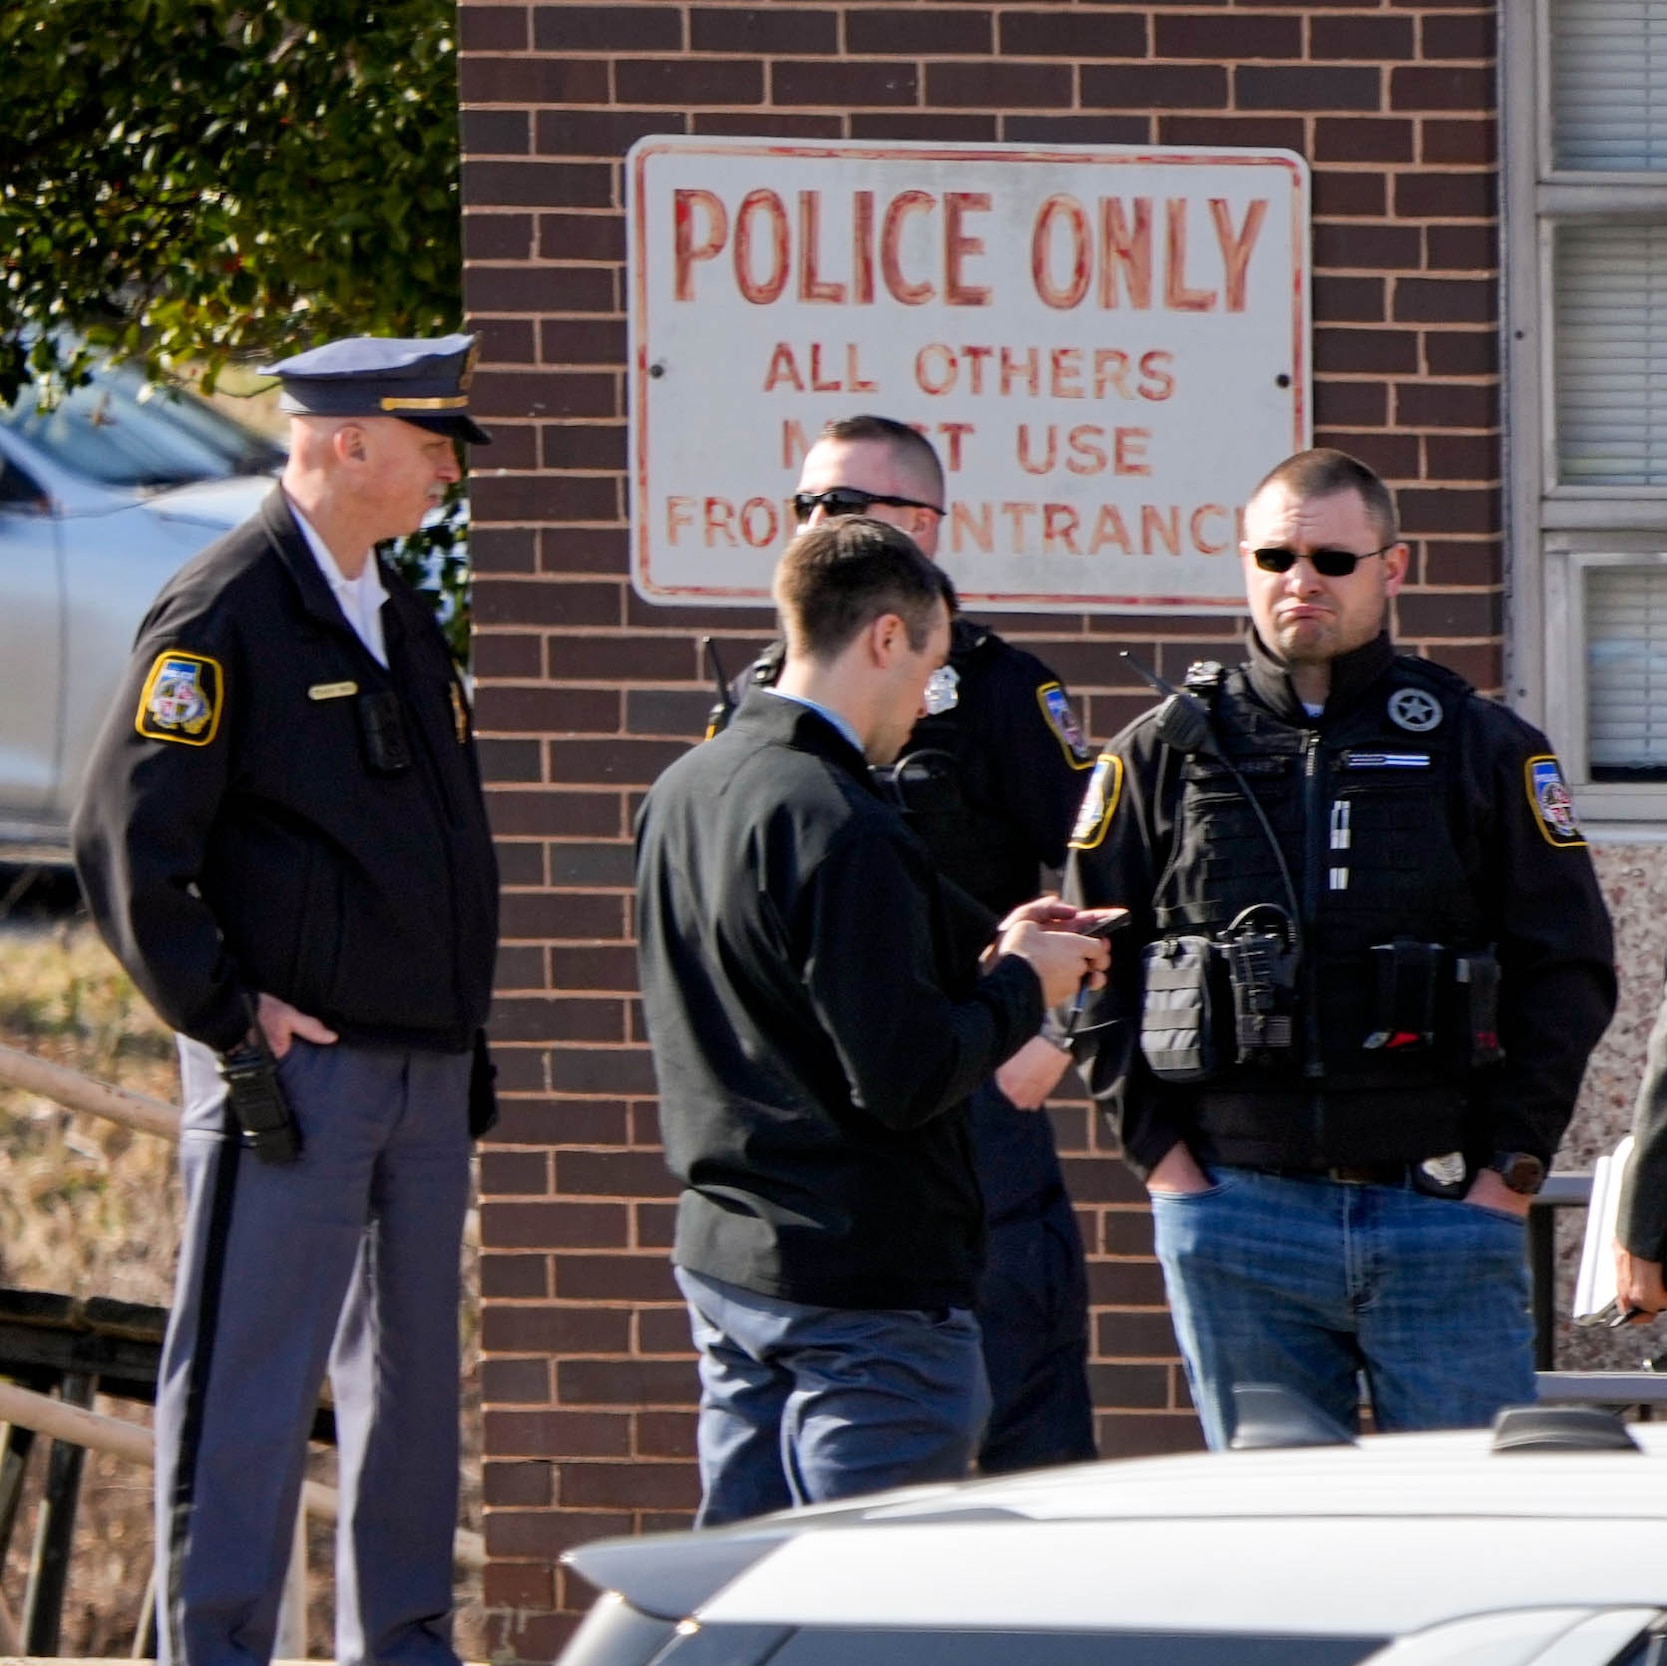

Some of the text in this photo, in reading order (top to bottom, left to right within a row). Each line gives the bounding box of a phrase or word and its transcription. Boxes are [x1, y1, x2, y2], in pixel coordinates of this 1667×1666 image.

[672, 187, 1269, 312] POLICE ONLY
[763, 341, 1175, 401] ALL OTHERS
[1017, 423, 1153, 477] USE
[666, 496, 1246, 557] FRO NTRANC
